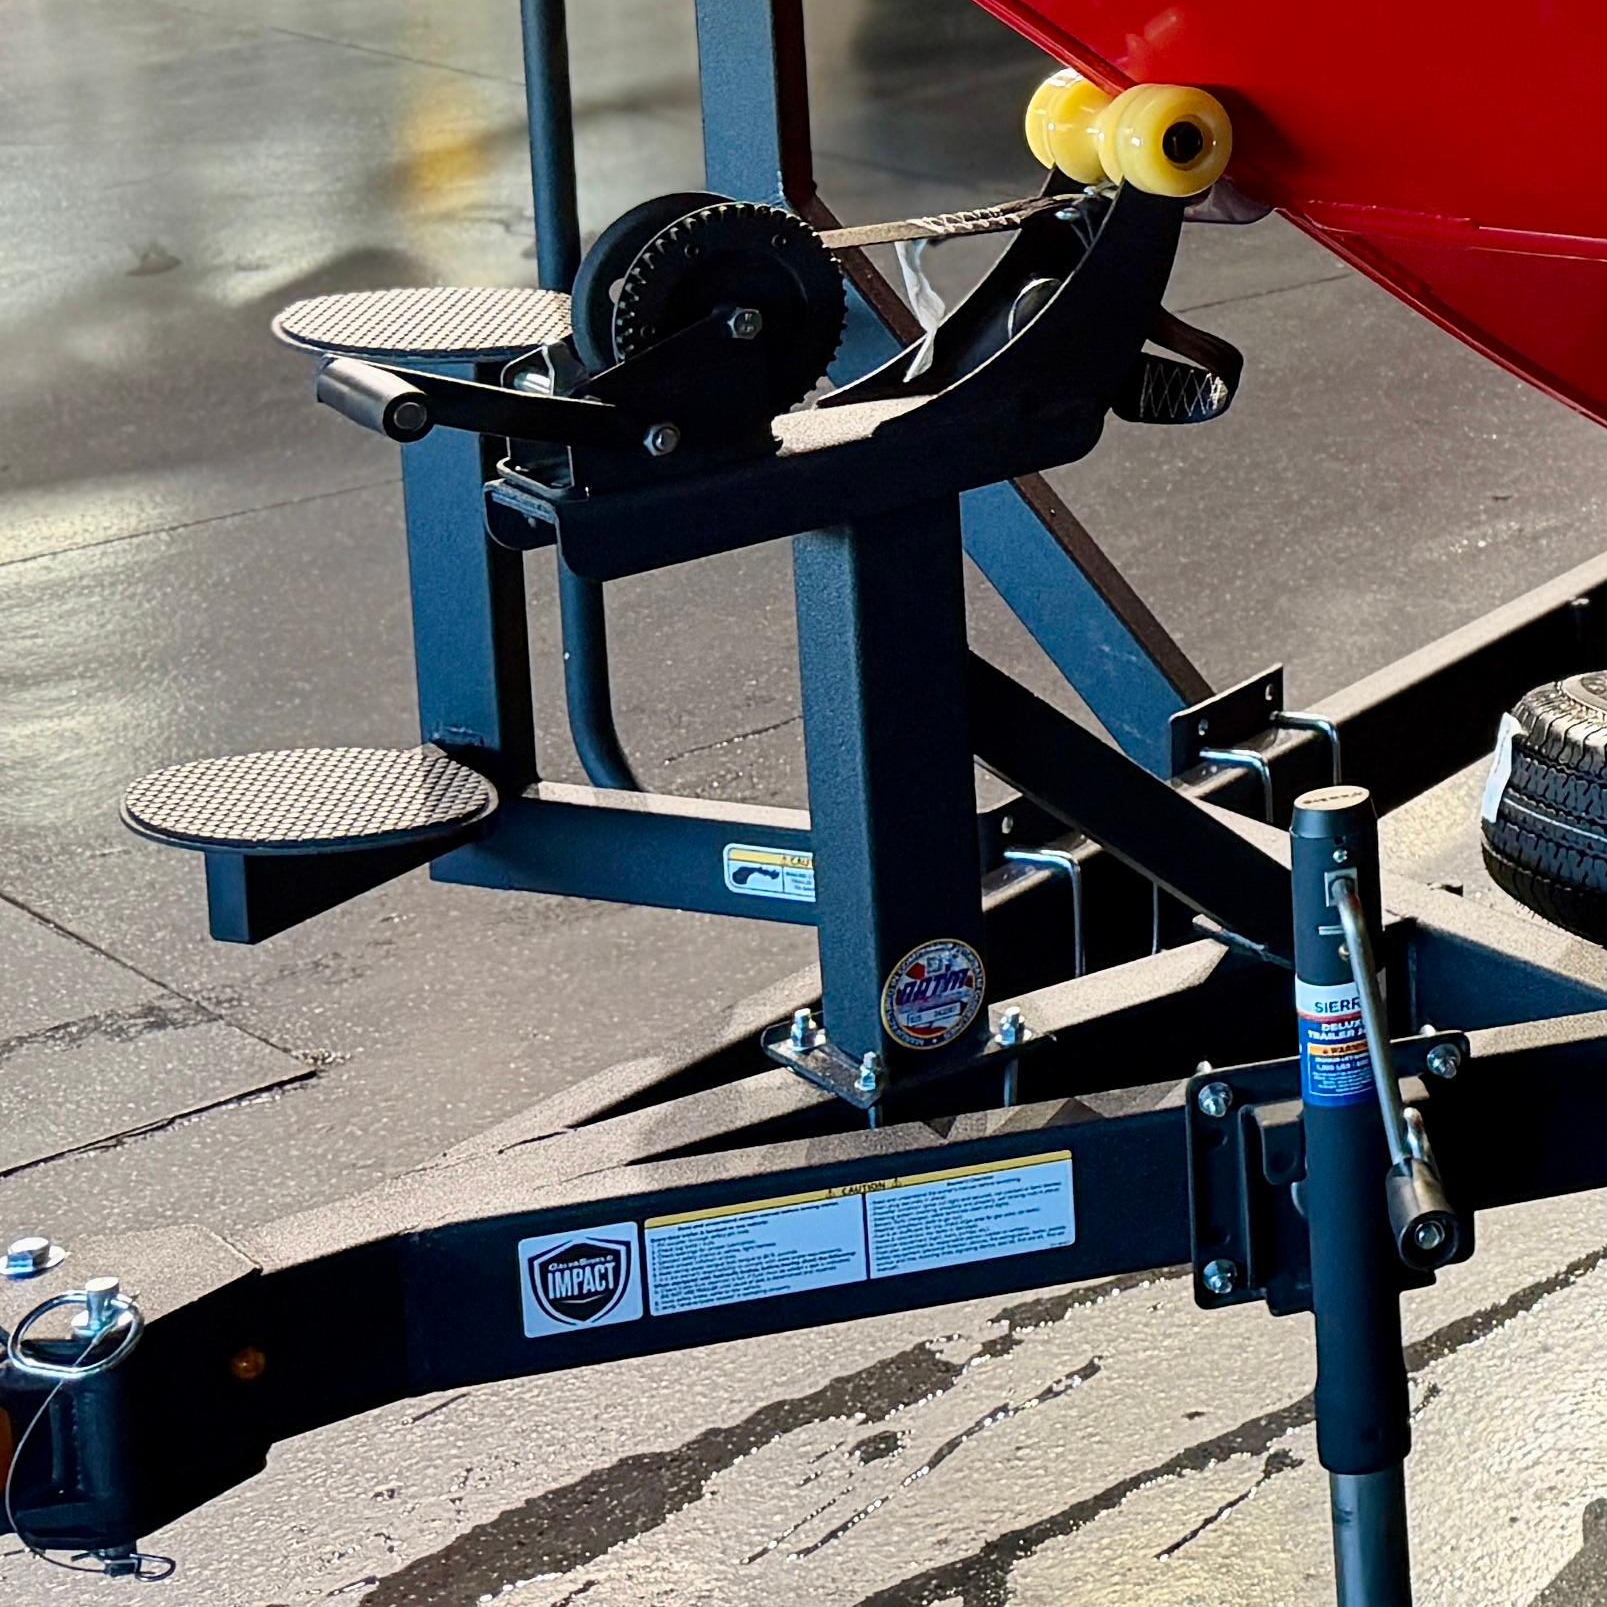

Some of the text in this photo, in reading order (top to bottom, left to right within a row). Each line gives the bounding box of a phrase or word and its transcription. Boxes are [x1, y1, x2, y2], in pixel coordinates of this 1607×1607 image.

[1314, 996, 1361, 1013] SIERR
[841, 1181, 886, 1196] CAUTION
[547, 1262, 616, 1299] IMPACT
